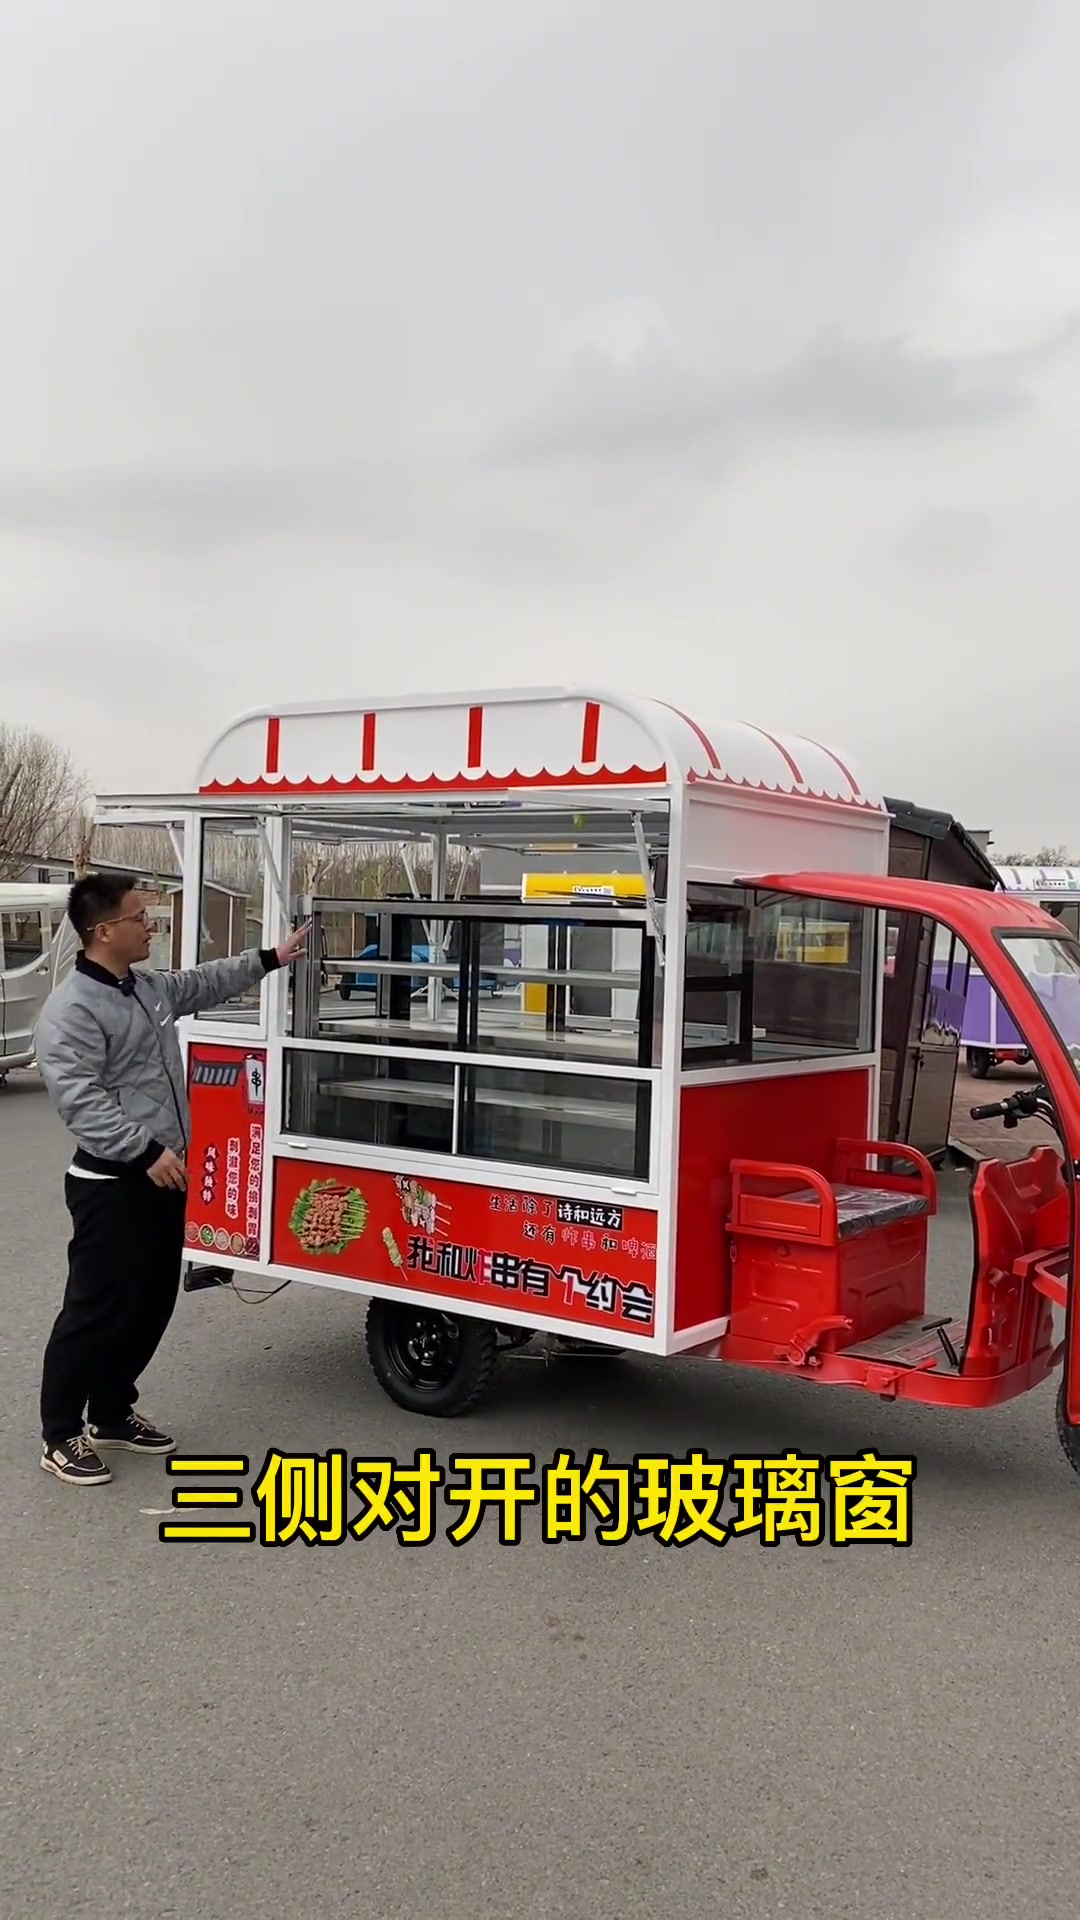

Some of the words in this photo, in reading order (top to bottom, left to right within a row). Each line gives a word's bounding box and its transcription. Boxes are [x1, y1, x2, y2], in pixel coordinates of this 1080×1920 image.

[489, 1194, 622, 1229] 生活除了诗和远方
[522, 1221, 656, 1260] 还有炸串和啤酒
[407, 1235, 654, 1324] 我和炸串有个约会
